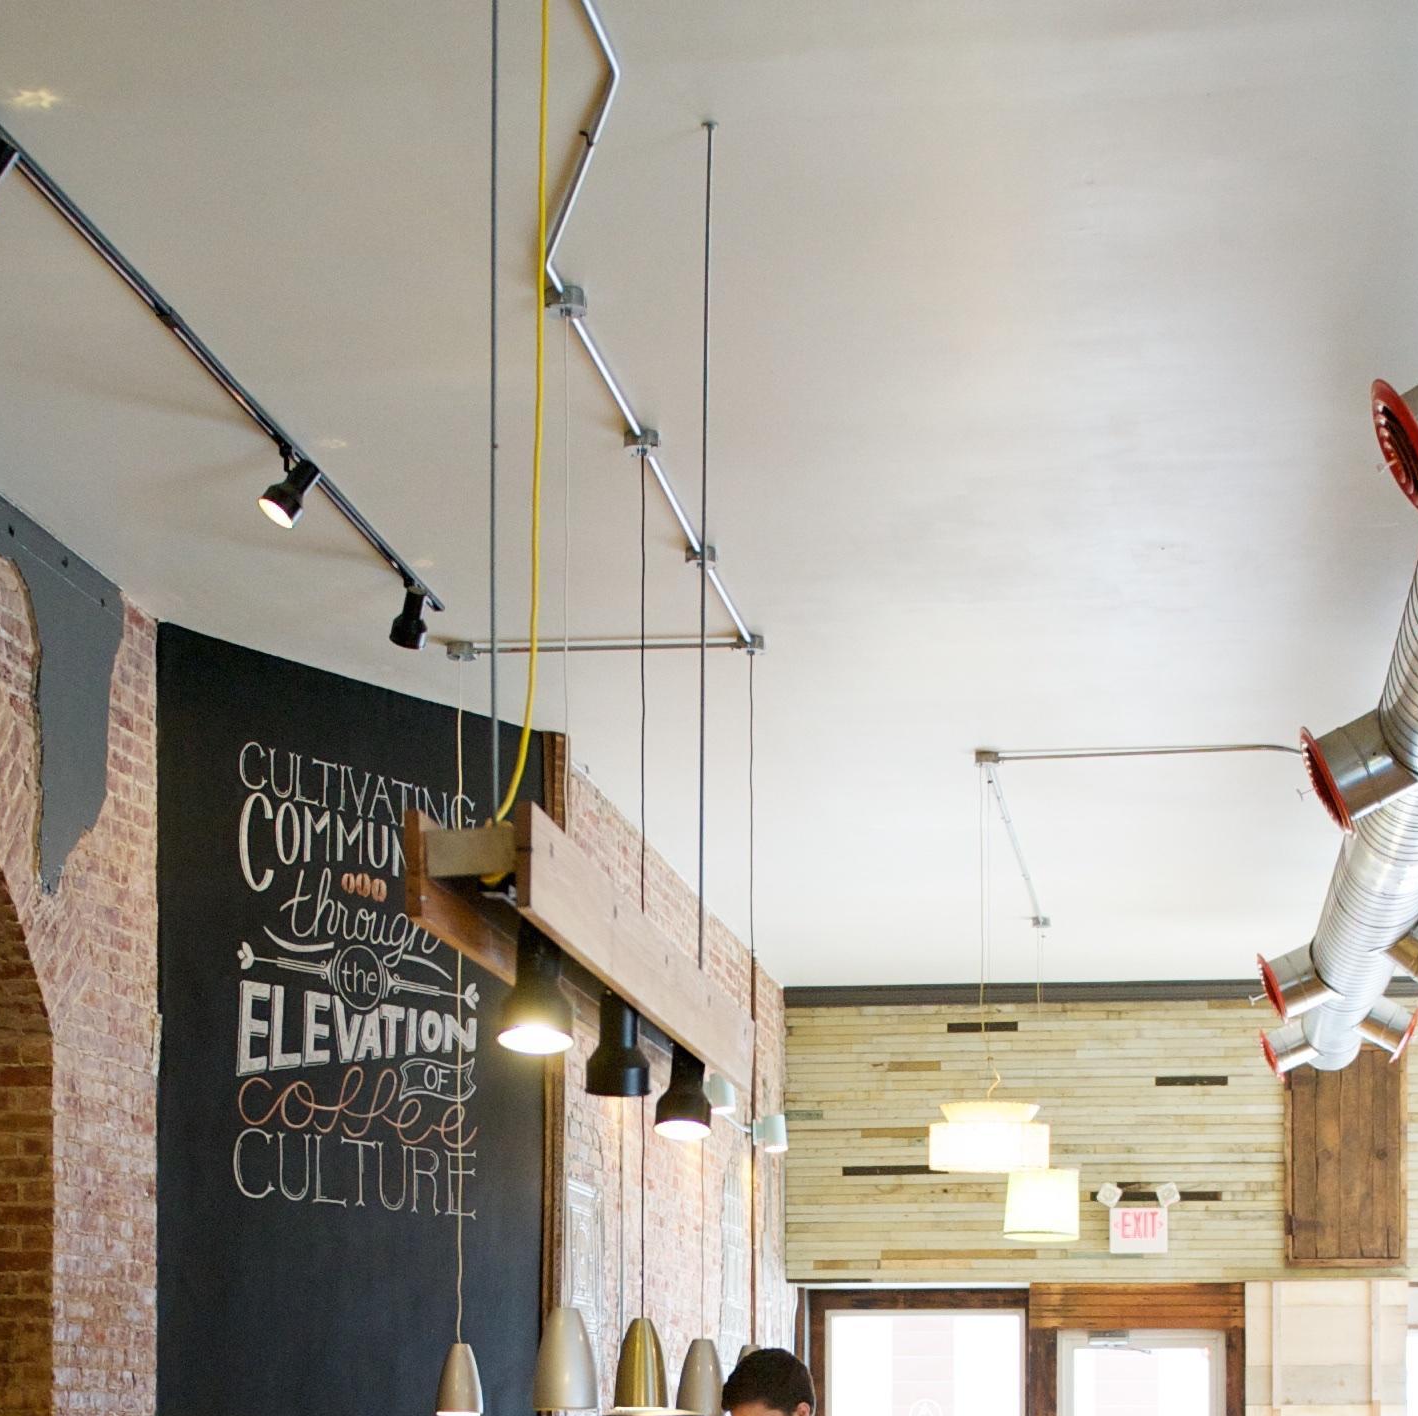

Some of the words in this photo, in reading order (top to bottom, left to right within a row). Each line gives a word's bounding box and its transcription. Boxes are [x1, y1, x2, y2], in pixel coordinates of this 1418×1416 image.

[238, 792, 408, 892] COMMUN
[341, 961, 378, 996] the
[236, 979, 478, 1077] ELEVATION
[238, 1066, 478, 1149] coffee
[424, 1064, 451, 1092] OF
[234, 1128, 477, 1220] CULTURE
[1121, 1211, 1159, 1239] EXIT
